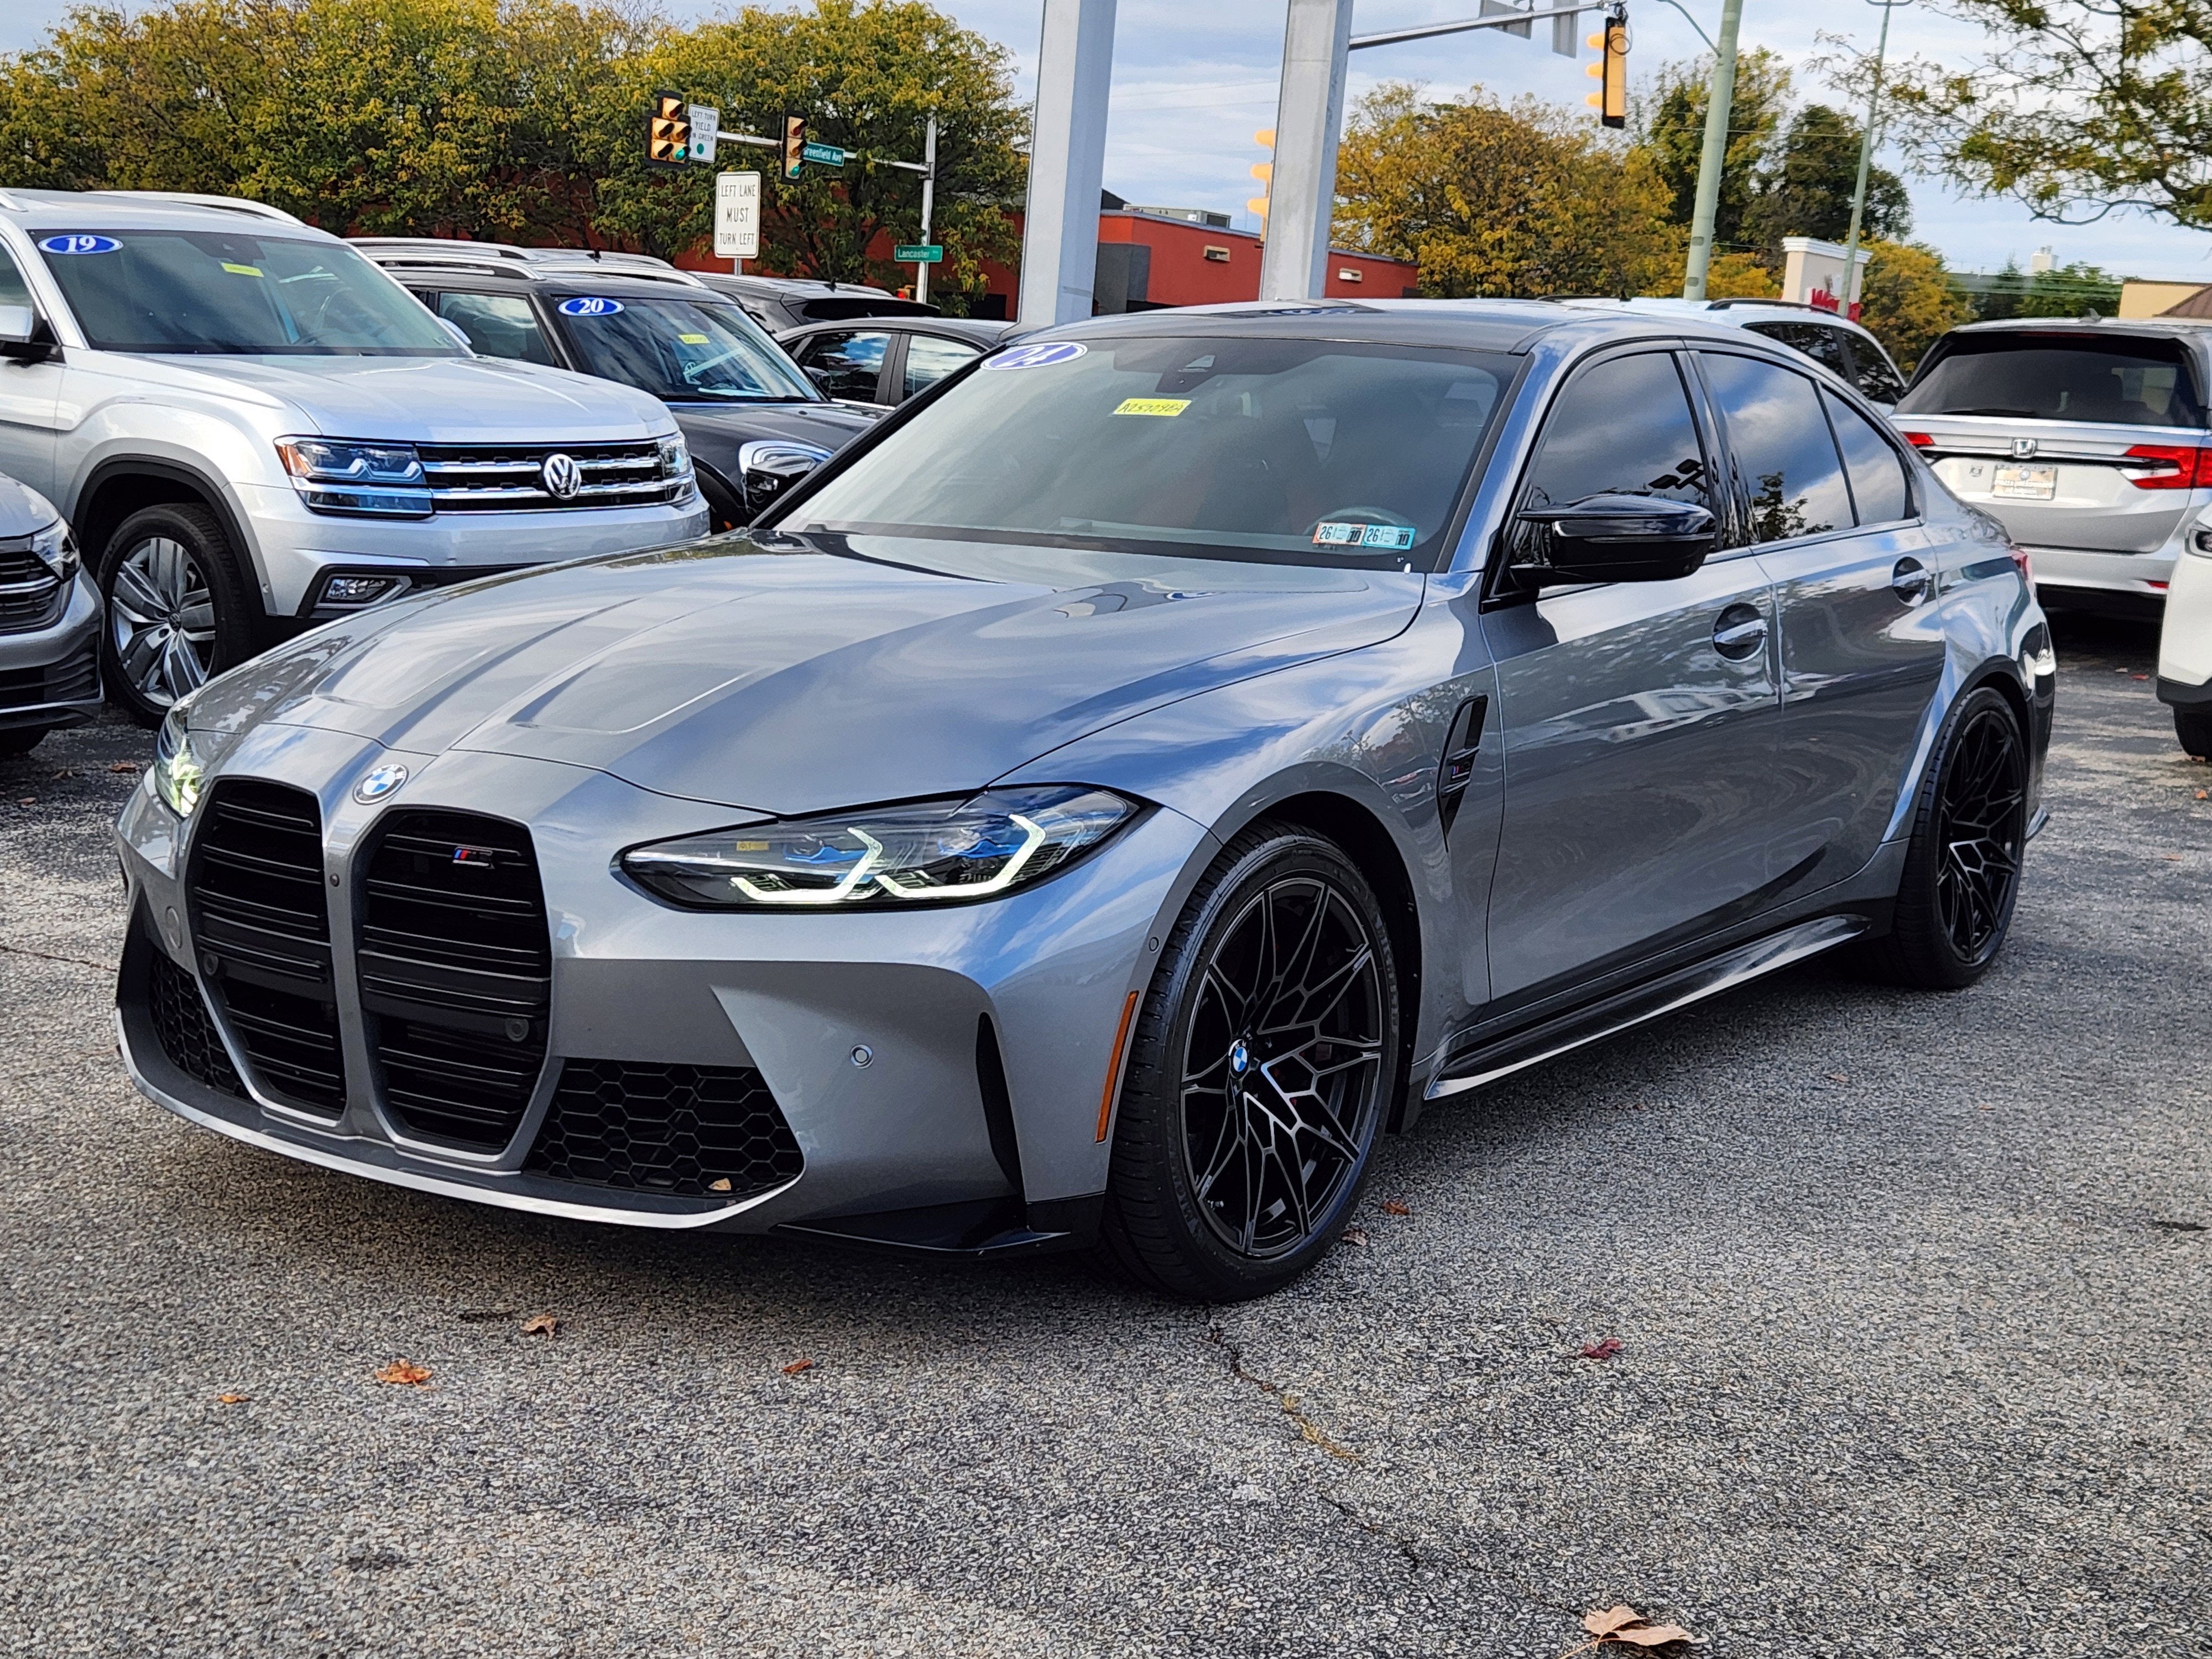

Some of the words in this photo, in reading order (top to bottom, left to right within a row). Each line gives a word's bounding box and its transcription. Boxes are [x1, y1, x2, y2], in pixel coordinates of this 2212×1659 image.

[692, 110, 703, 119] LEFT
[704, 112, 716, 121] TURN
[695, 121, 711, 132] YIELD
[698, 133, 713, 142] GREEN
[832, 151, 842, 163] Ave
[721, 185, 737, 197] LEFT
[739, 184, 756, 197] LANE
[726, 207, 749, 222] MUST
[64, 236, 96, 253] 19
[719, 232, 736, 245] TURN
[739, 232, 754, 245] LEFT
[898, 248, 930, 258] Lancaster
[578, 299, 604, 314] 20
[994, 344, 1072, 368] 24
[1318, 525, 1333, 540] 26
[1347, 530, 1362, 543] 10
[1366, 528, 1380, 542] 26
[1397, 533, 1410, 546] 10
